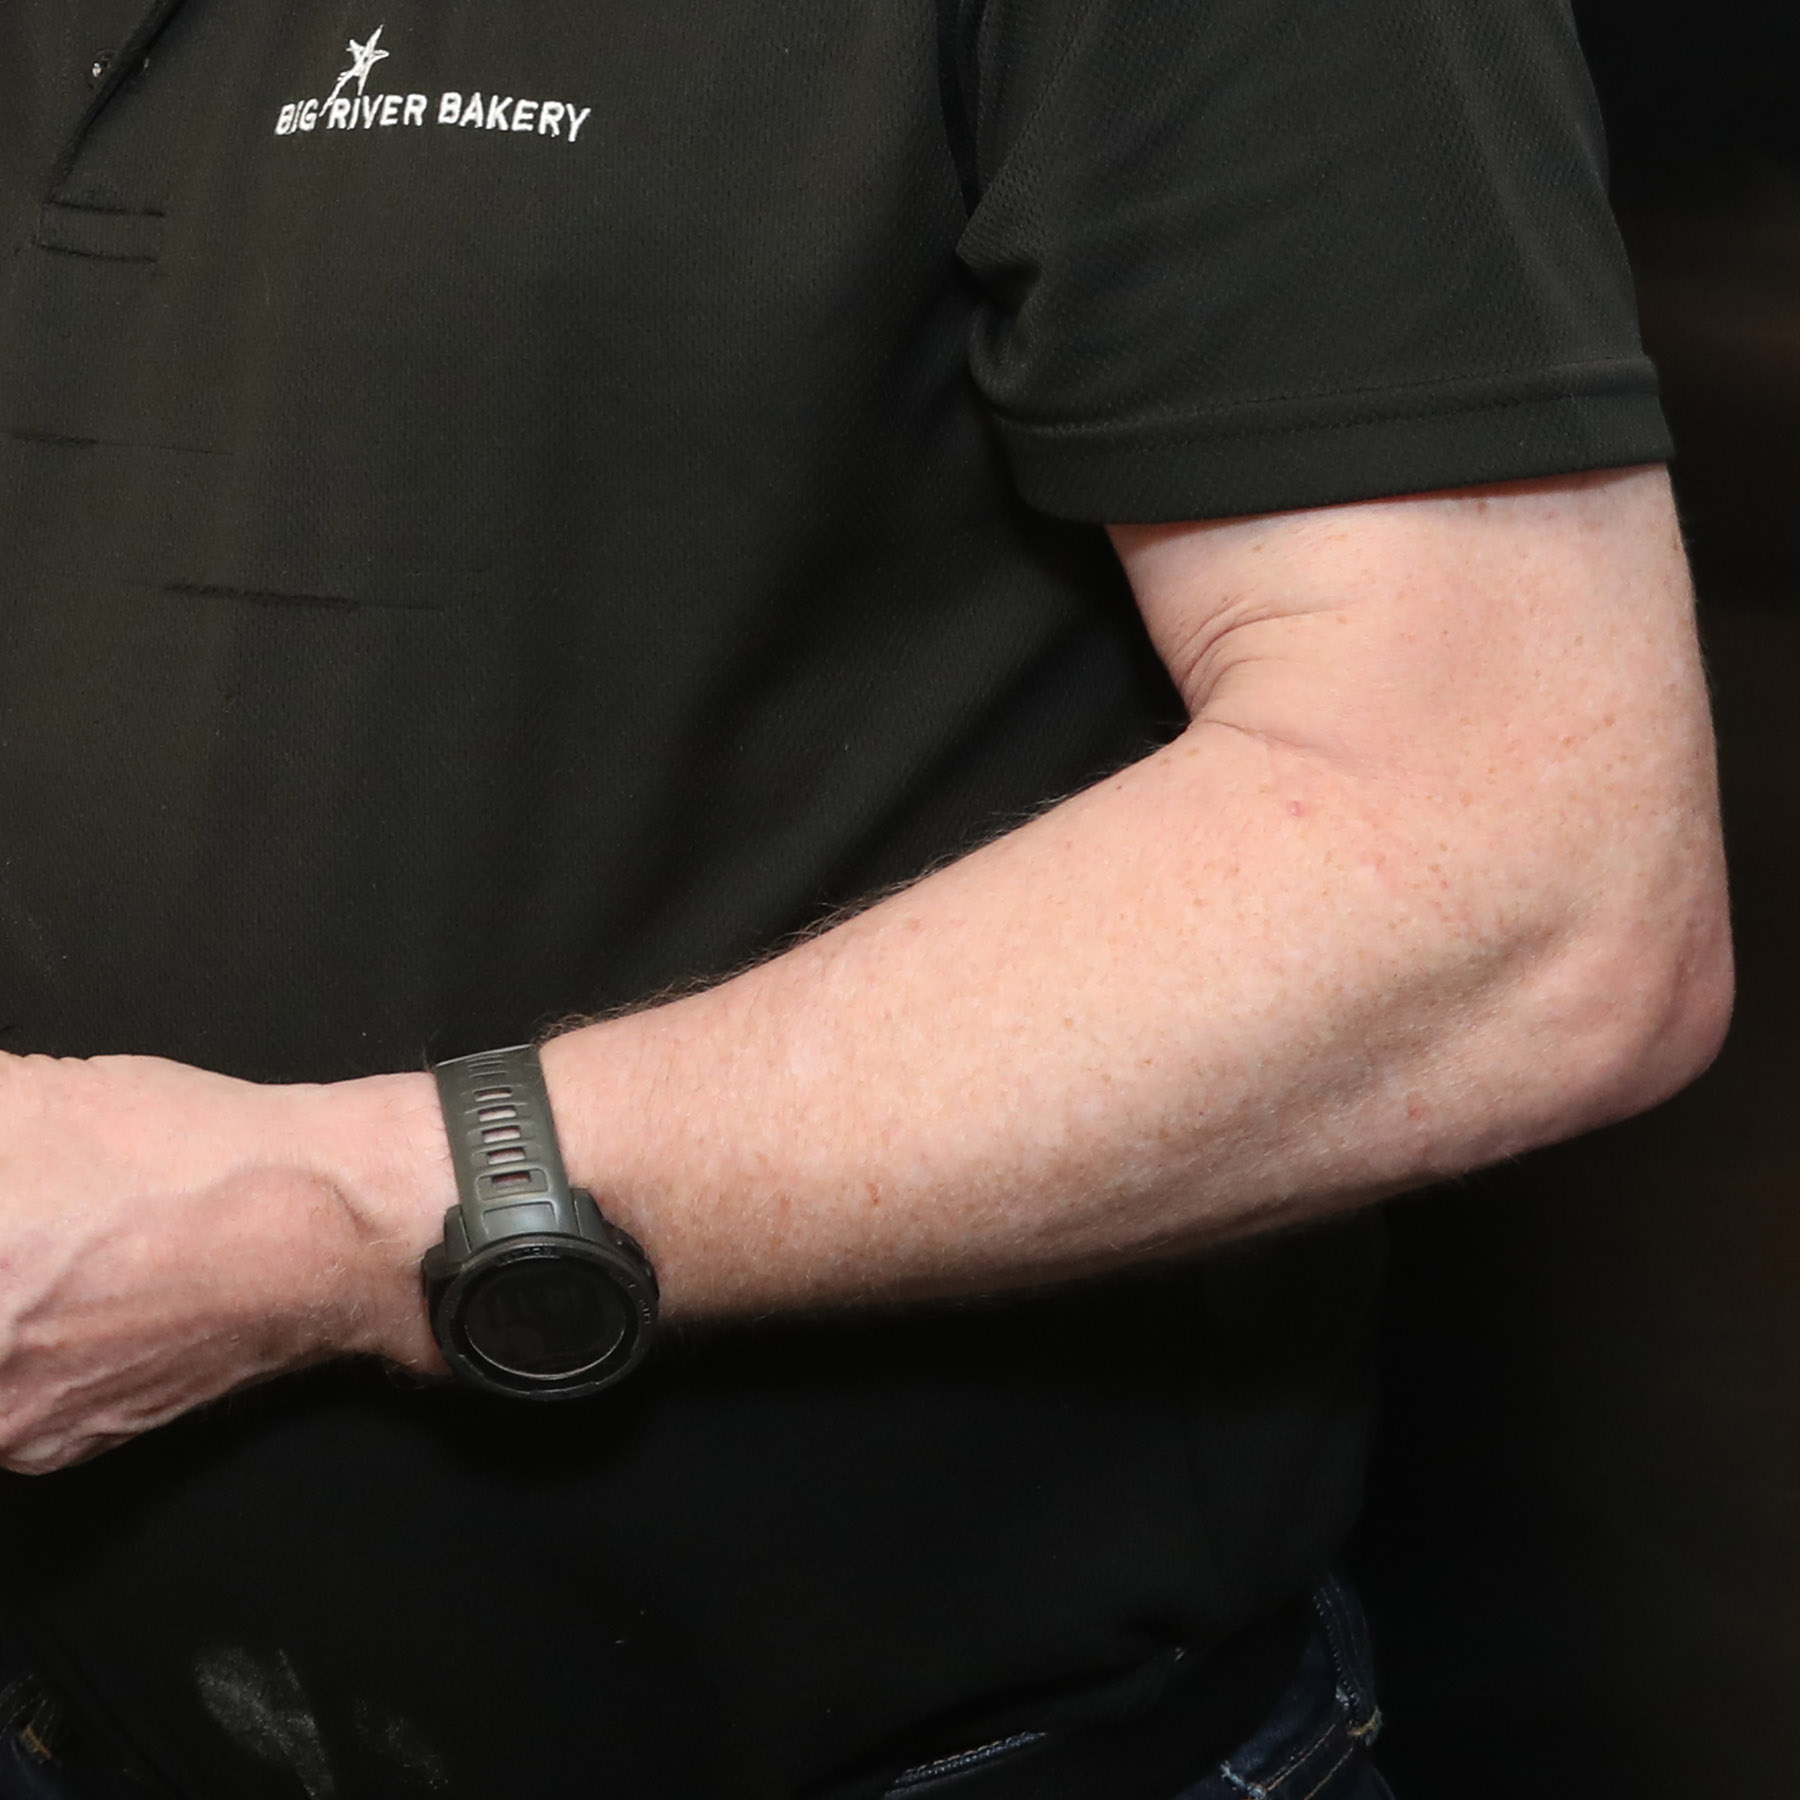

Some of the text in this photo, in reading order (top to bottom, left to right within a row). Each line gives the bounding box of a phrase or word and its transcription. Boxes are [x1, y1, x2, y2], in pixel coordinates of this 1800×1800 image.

[275, 91, 592, 143] BIG RIVER BAKERY
